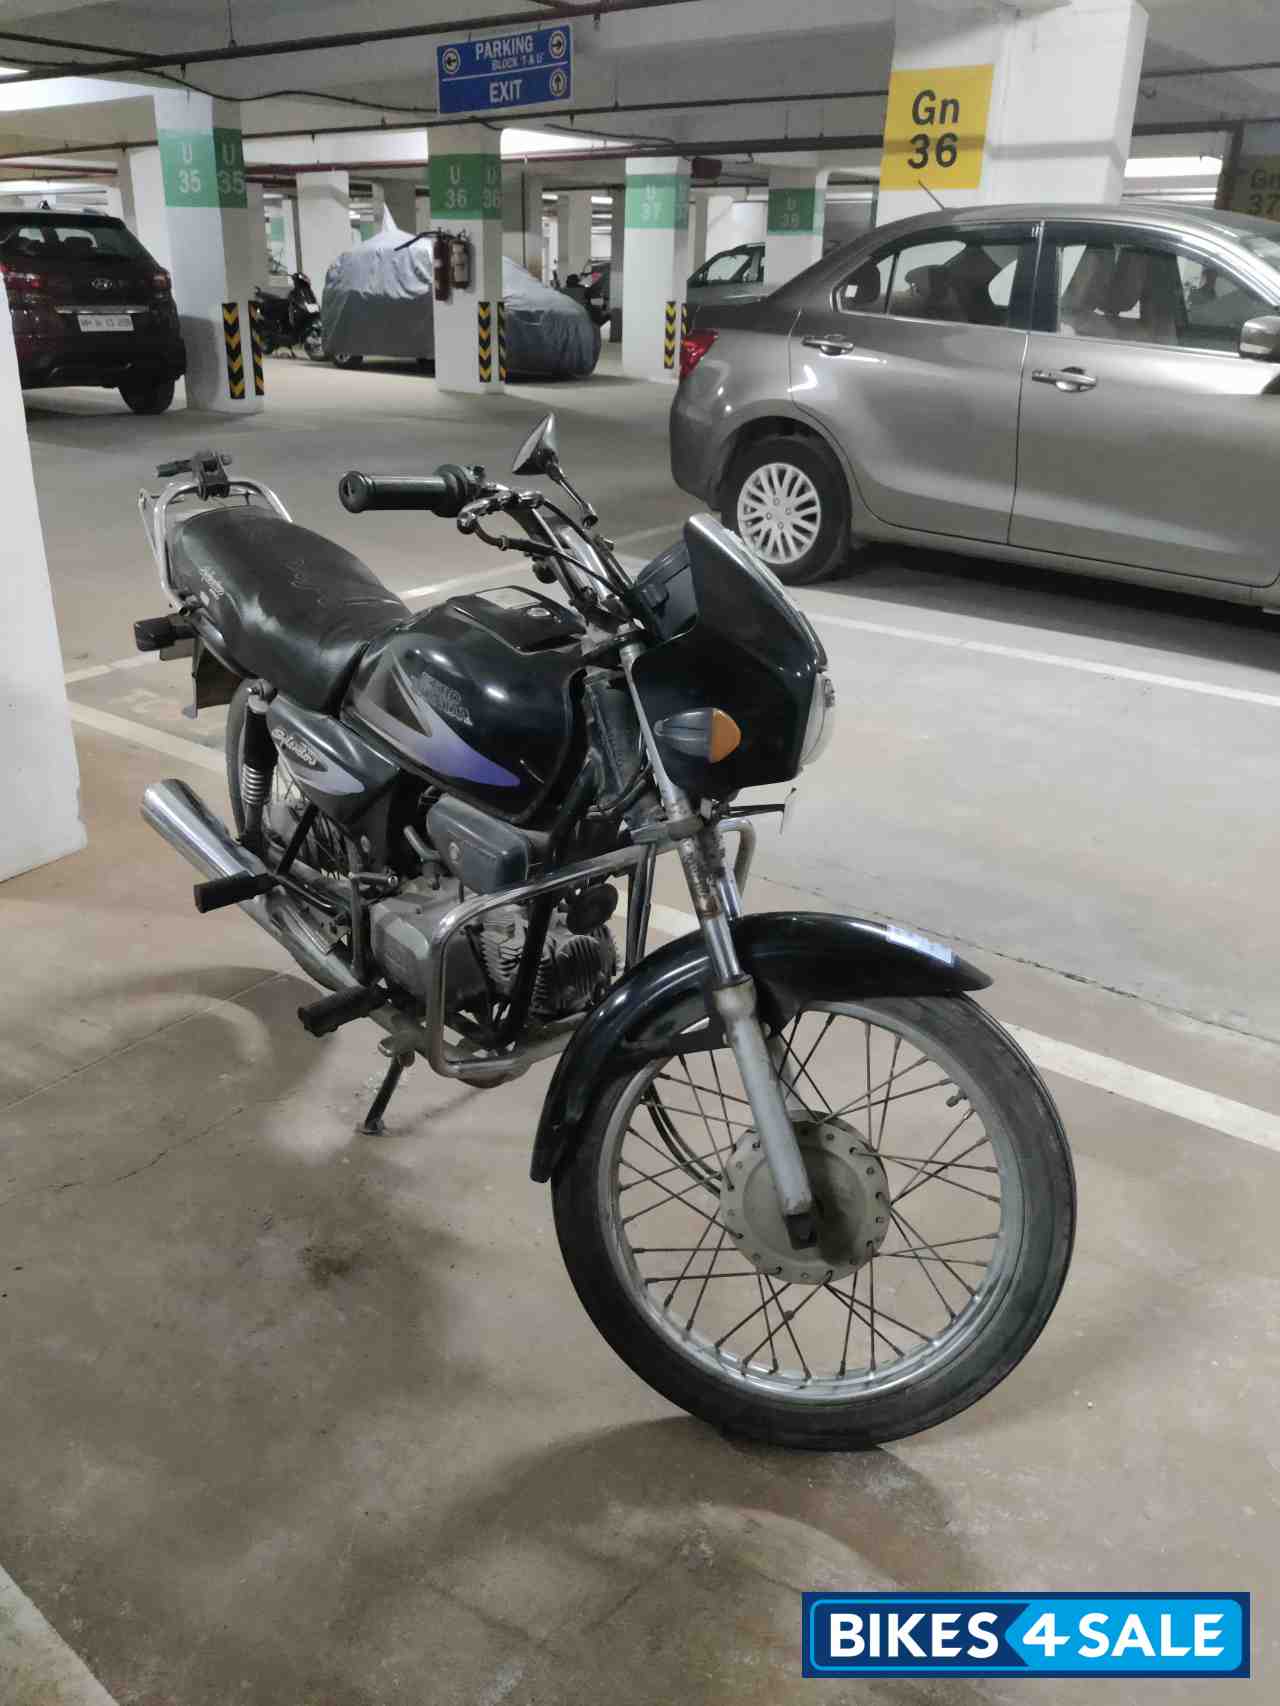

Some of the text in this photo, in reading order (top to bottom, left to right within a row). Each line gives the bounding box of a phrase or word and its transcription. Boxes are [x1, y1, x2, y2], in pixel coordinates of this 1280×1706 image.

[475, 36, 534, 61] PARKING
[490, 80, 521, 103] EXIT
[912, 89, 960, 125] Gn
[182, 143, 193, 163] U
[907, 132, 958, 169] 36
[178, 169, 201, 193] 35
[450, 166, 460, 185] U
[445, 189, 466, 209] 36
